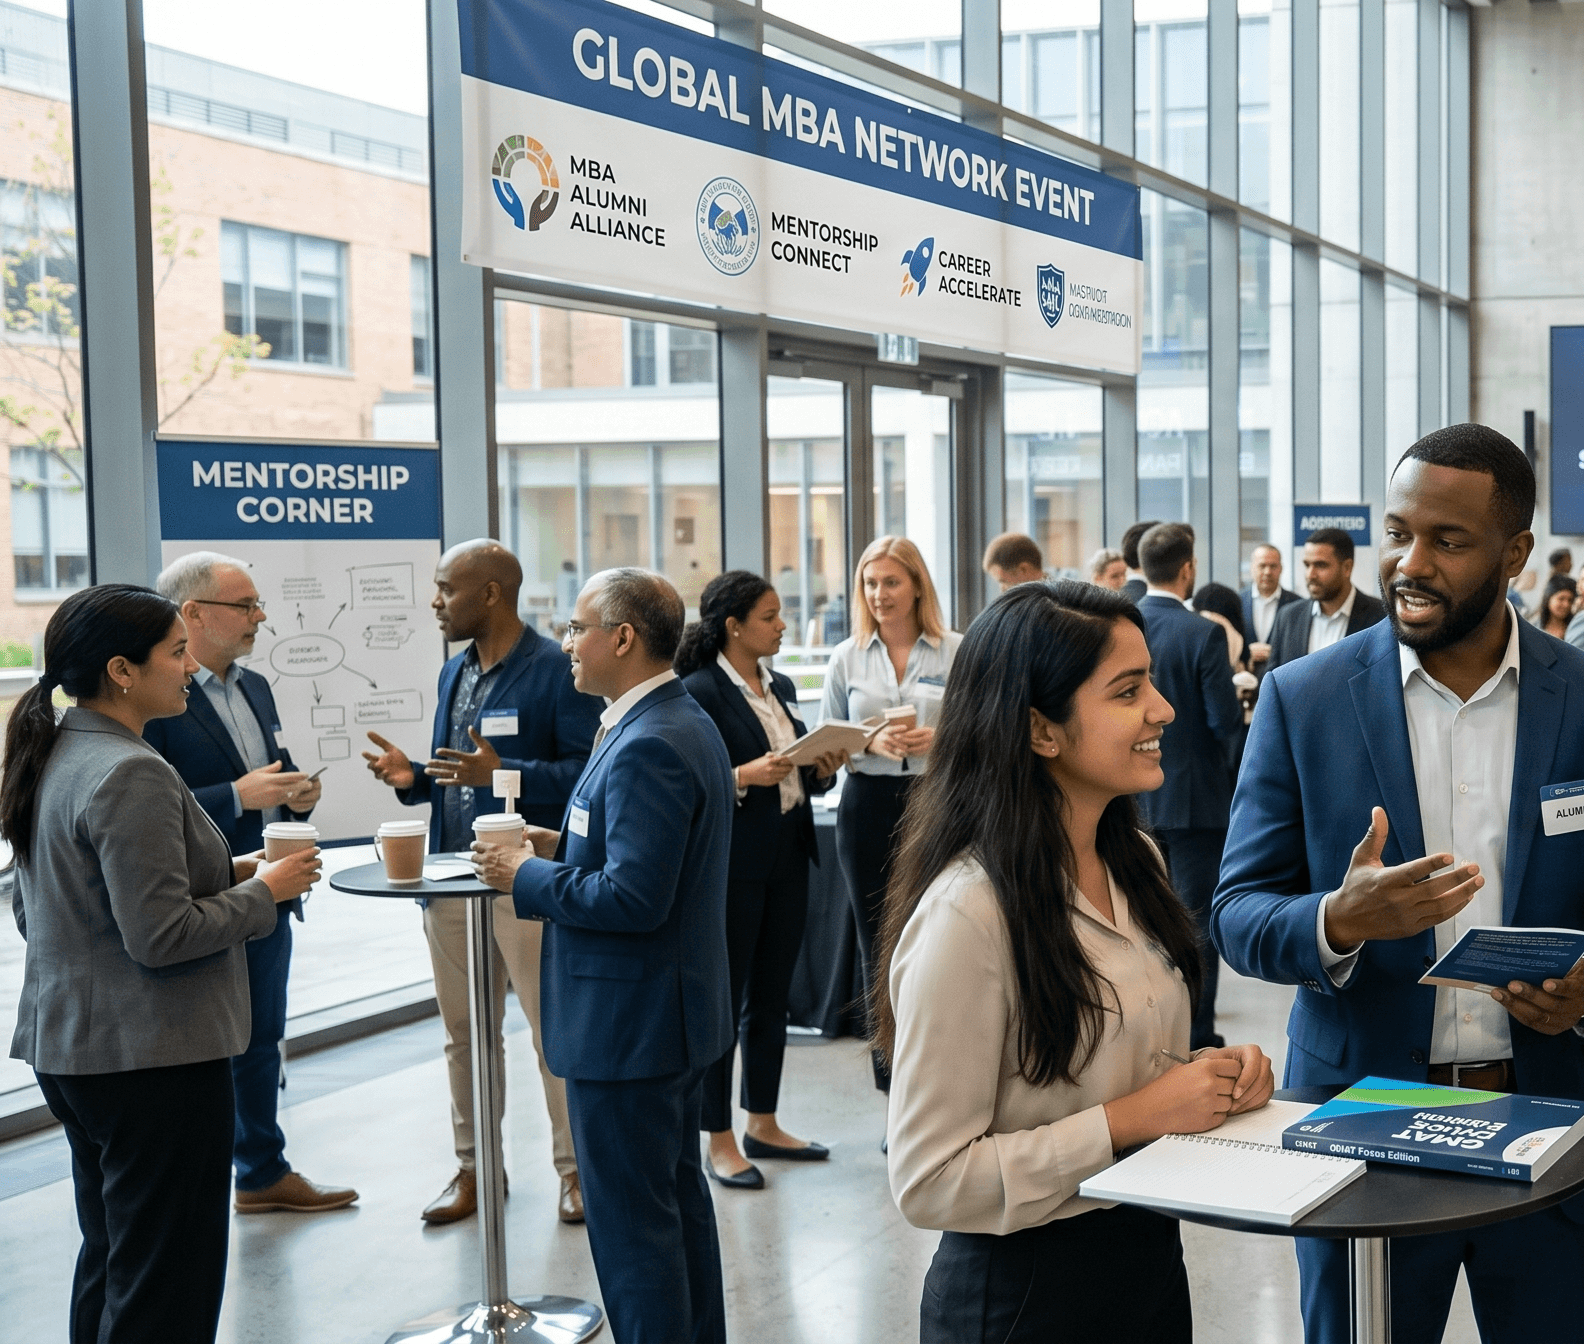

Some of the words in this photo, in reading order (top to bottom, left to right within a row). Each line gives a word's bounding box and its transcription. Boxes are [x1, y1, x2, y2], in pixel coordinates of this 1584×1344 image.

[572, 27, 750, 126] GLOBAL
[762, 85, 846, 154] MBA
[855, 115, 1009, 202] NETWORK
[1015, 167, 1095, 226] EVENT
[570, 155, 616, 184] MBA
[570, 184, 647, 217] ALUMNI
[570, 212, 666, 247] ALLIANCE
[771, 211, 879, 252] MENTORSHIP
[771, 240, 851, 274] CONNECT
[938, 250, 991, 278] CAREER
[938, 275, 1022, 307] ACCELERATE
[192, 460, 410, 491] MENTORSHIP
[236, 496, 374, 523] CORNER
[1390, 1129, 1485, 1150] GMAT
